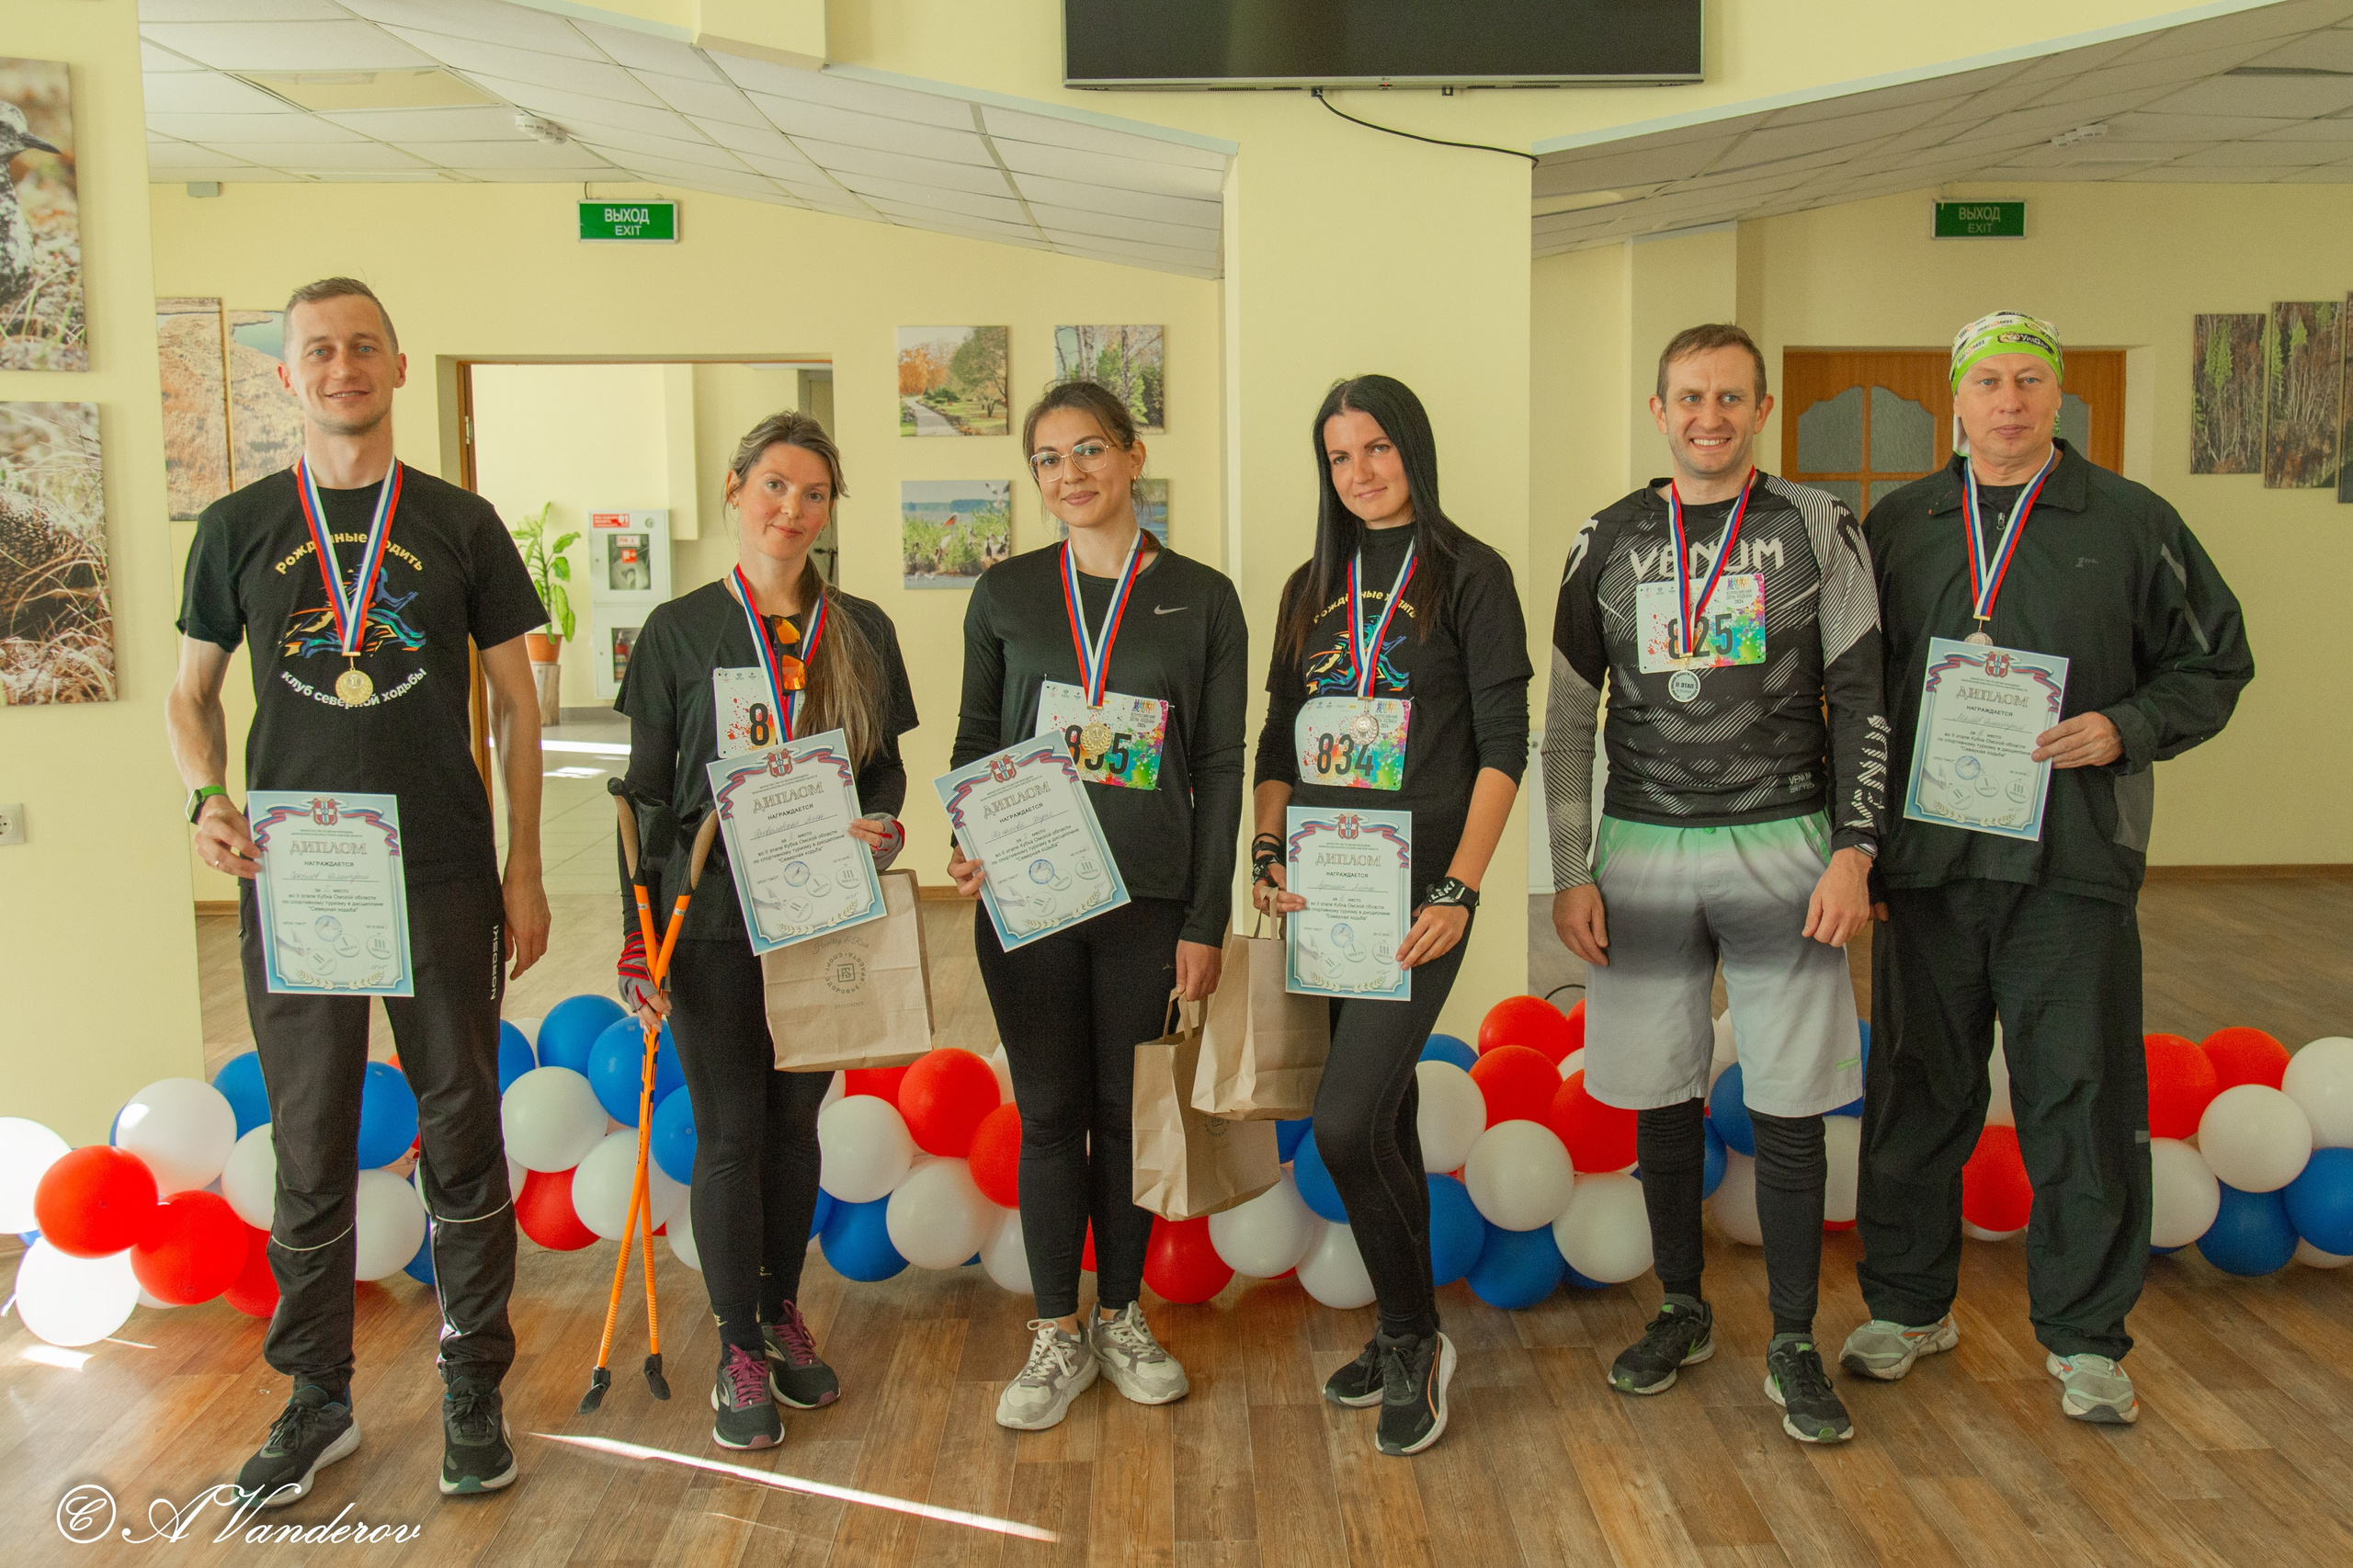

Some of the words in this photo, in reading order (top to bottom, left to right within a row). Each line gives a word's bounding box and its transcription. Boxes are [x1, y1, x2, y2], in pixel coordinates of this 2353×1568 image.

[604, 208, 650, 225] ВЫХОД
[1959, 207, 2001, 222] ВЫХОД
[615, 225, 642, 235] EXIT
[1968, 223, 1994, 233] EXIT
[385, 540, 424, 572] одить
[281, 671, 314, 697] клуб
[381, 668, 428, 702] ходьбы
[1956, 686, 2029, 710] ДИПЛОМ
[1966, 706, 2013, 717] НАГРАЖДАЕТСЯ
[1317, 733, 1374, 777] 834
[1945, 738, 1976, 748] спортивному
[2001, 748, 2030, 756] дисциплине
[1960, 746, 1985, 755] "Северная
[1986, 750, 2006, 758] ходьба"
[751, 781, 824, 814] ДИПЛОМ
[980, 781, 1052, 820] ДИПЛОМ
[767, 803, 814, 821] НАГРАЖДАЕТСЯ
[999, 802, 1044, 824] НАГРАЖДАЕТСЯ
[768, 846, 783, 854] этапе
[784, 841, 799, 850] Кубка
[799, 835, 817, 845] Омской
[818, 830, 838, 839] области
[1006, 846, 1020, 855] этапе
[1019, 839, 1034, 849] Кубка
[1033, 832, 1052, 843] Омской
[1051, 824, 1072, 835] области
[1031, 828, 1046, 837] место
[289, 840, 368, 858] ДИПЛОМ
[760, 849, 792, 863] спортивному
[792, 844, 813, 854] туризму
[817, 835, 846, 846] дисциплине
[778, 852, 804, 864] "Северная
[804, 846, 824, 856] ходьба"
[998, 848, 1029, 864] спортивному
[1029, 841, 1048, 852] туризму
[1051, 828, 1079, 843] дисциплине
[1016, 848, 1040, 862] "Северная
[1040, 841, 1060, 852] ходьба"
[1315, 853, 1381, 869] ДИПЛОМ
